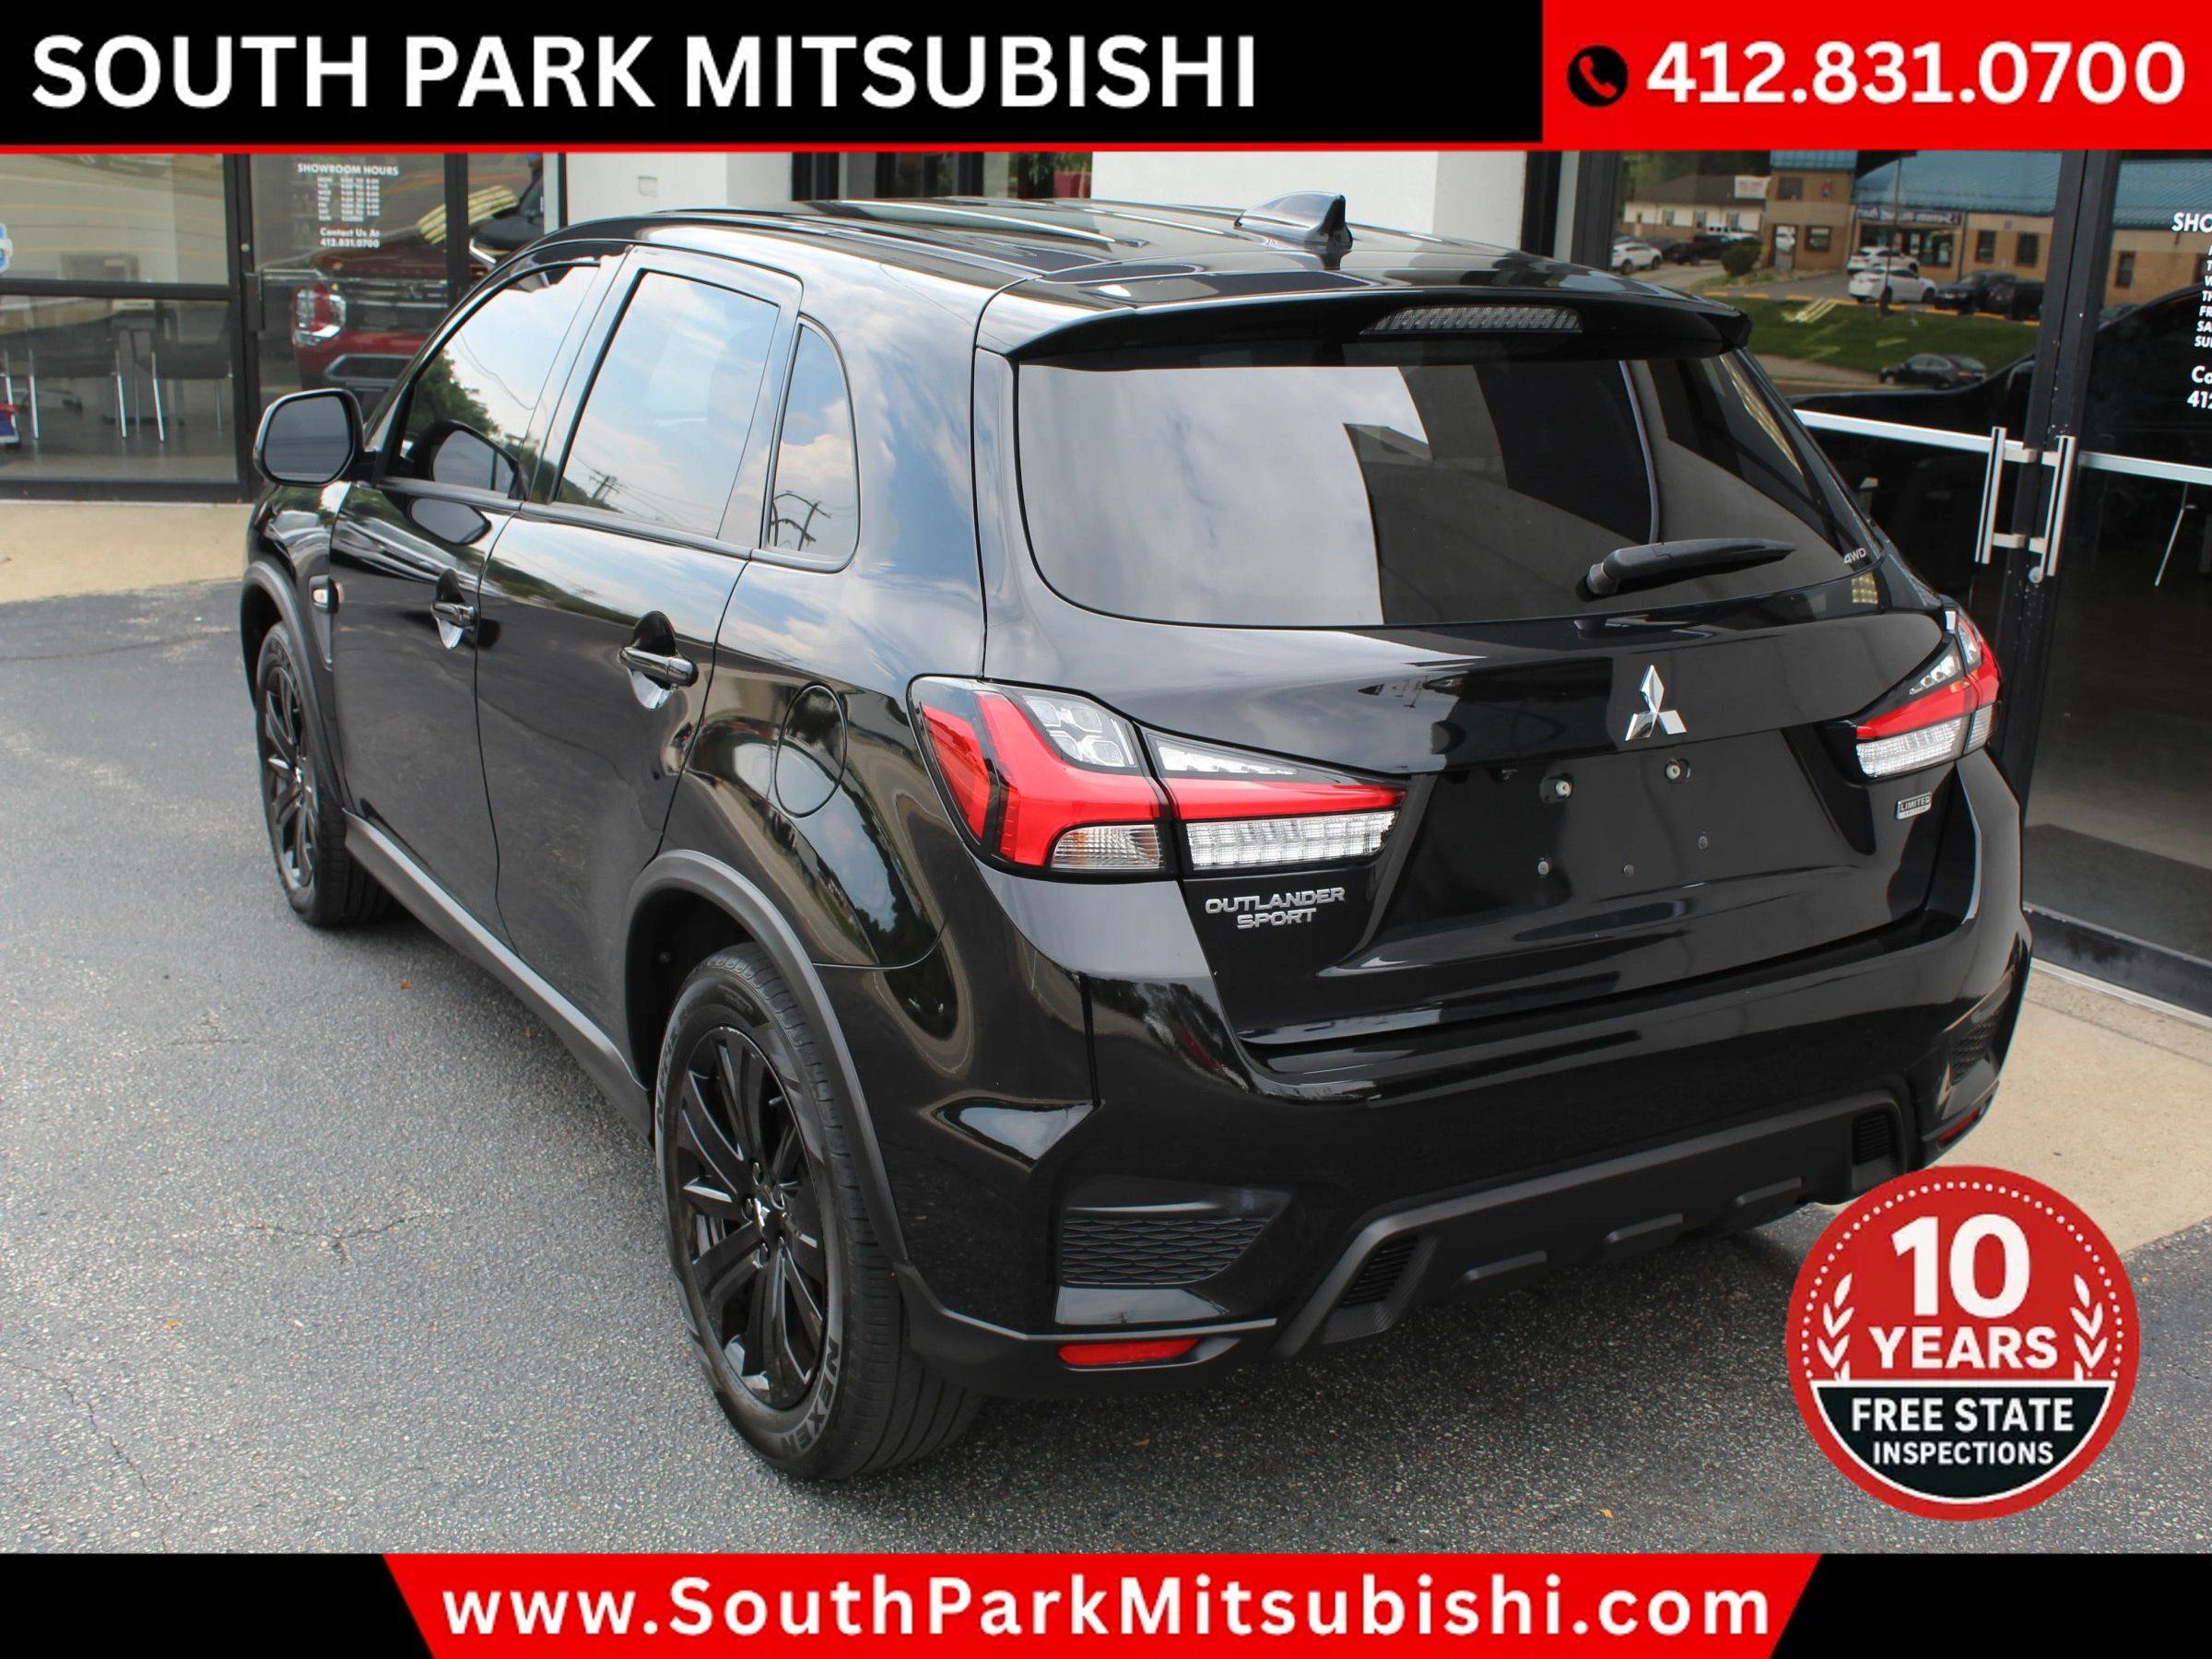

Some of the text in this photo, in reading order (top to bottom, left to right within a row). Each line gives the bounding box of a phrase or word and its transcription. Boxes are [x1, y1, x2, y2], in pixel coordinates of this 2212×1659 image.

[298, 163, 398, 176] SHOWROOM HOURS
[2194, 335, 2212, 347] SU
[1844, 547, 1866, 563] 4WD
[1206, 887, 1346, 914] OUTLANDER
[1237, 907, 1317, 930] SPORT
